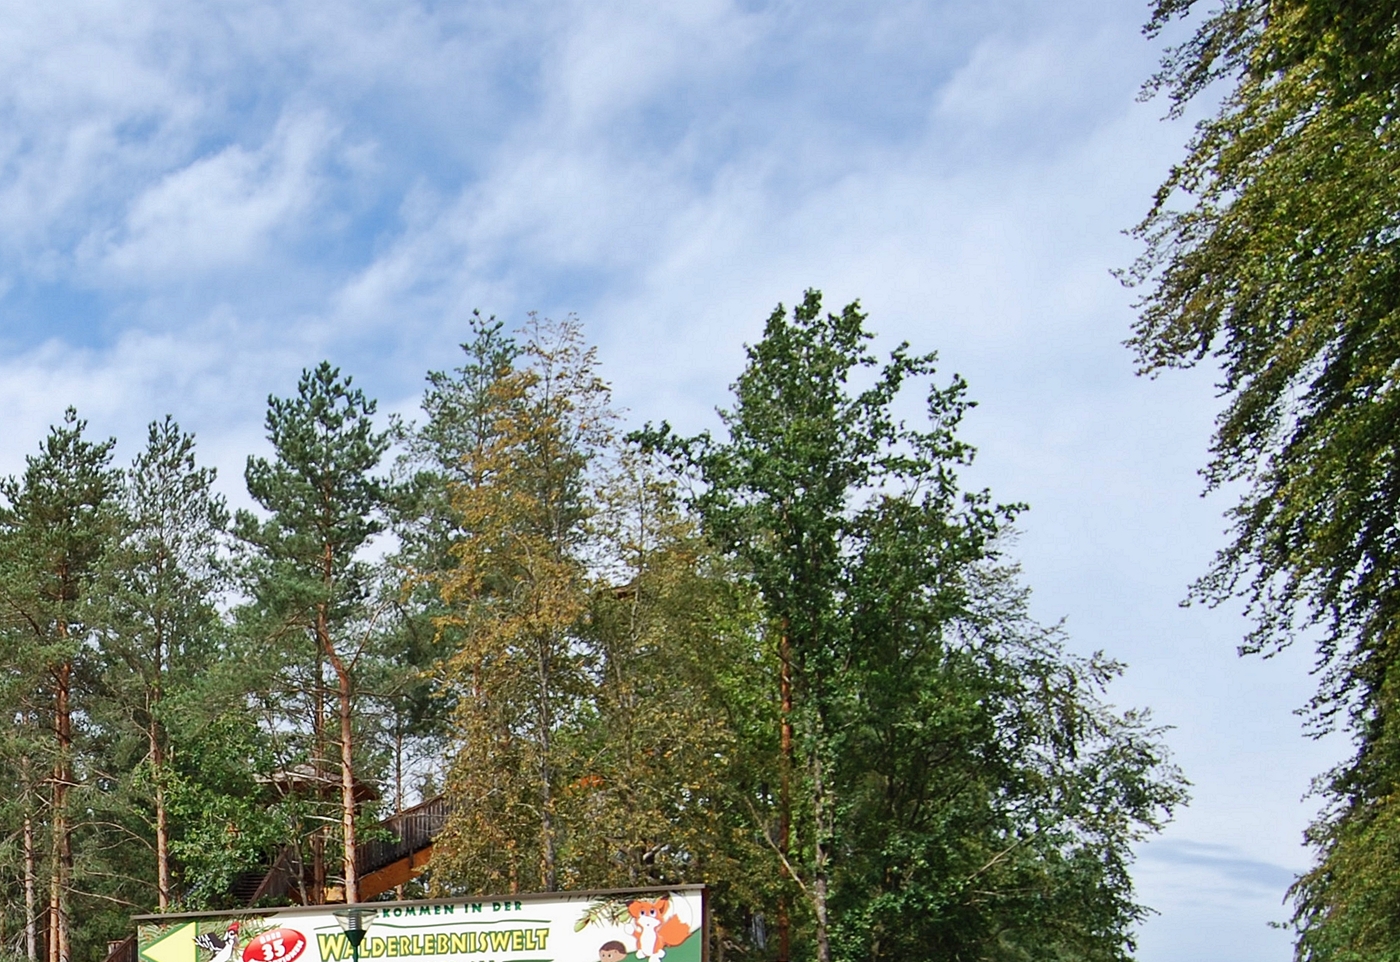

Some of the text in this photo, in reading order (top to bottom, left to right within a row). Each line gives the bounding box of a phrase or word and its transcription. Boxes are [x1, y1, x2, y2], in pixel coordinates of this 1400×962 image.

[375, 901, 523, 918] KOMMEN IN DER
[261, 939, 286, 961] 35
[317, 928, 550, 962] WALDERLEBNISWELT
